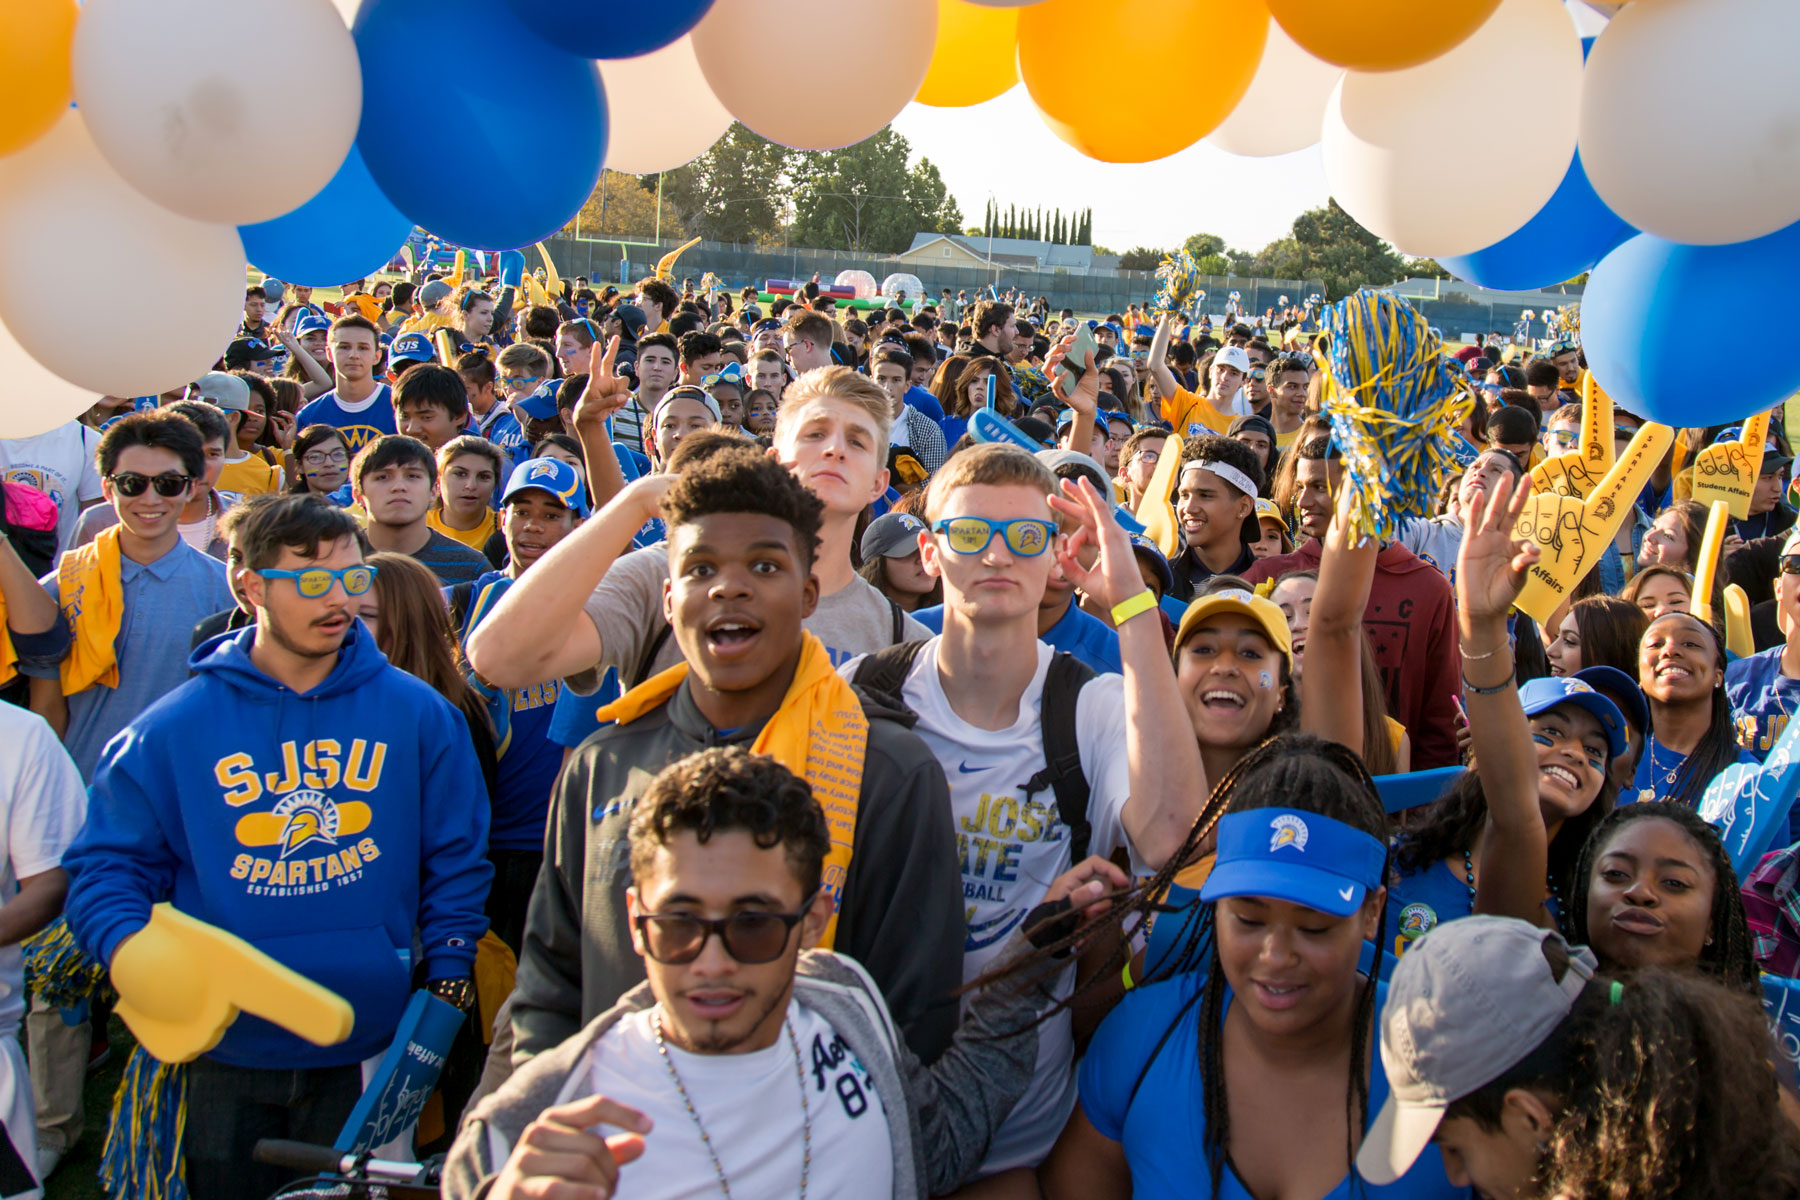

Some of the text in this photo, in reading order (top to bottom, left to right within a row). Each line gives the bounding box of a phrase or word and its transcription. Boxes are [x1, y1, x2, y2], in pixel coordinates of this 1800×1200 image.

[398, 339, 419, 351] SJS
[1609, 435, 1654, 499] SPARTANS
[1697, 481, 1751, 498] Student Affairs
[950, 526, 989, 535] SPARTAN
[1530, 564, 1564, 594] Affairs
[213, 738, 388, 808] SJSU
[825, 760, 844, 771] and
[229, 837, 380, 886] SPARTANS
[246, 869, 364, 897] ESTABLISHED 1857
[962, 881, 1006, 903] BALL
